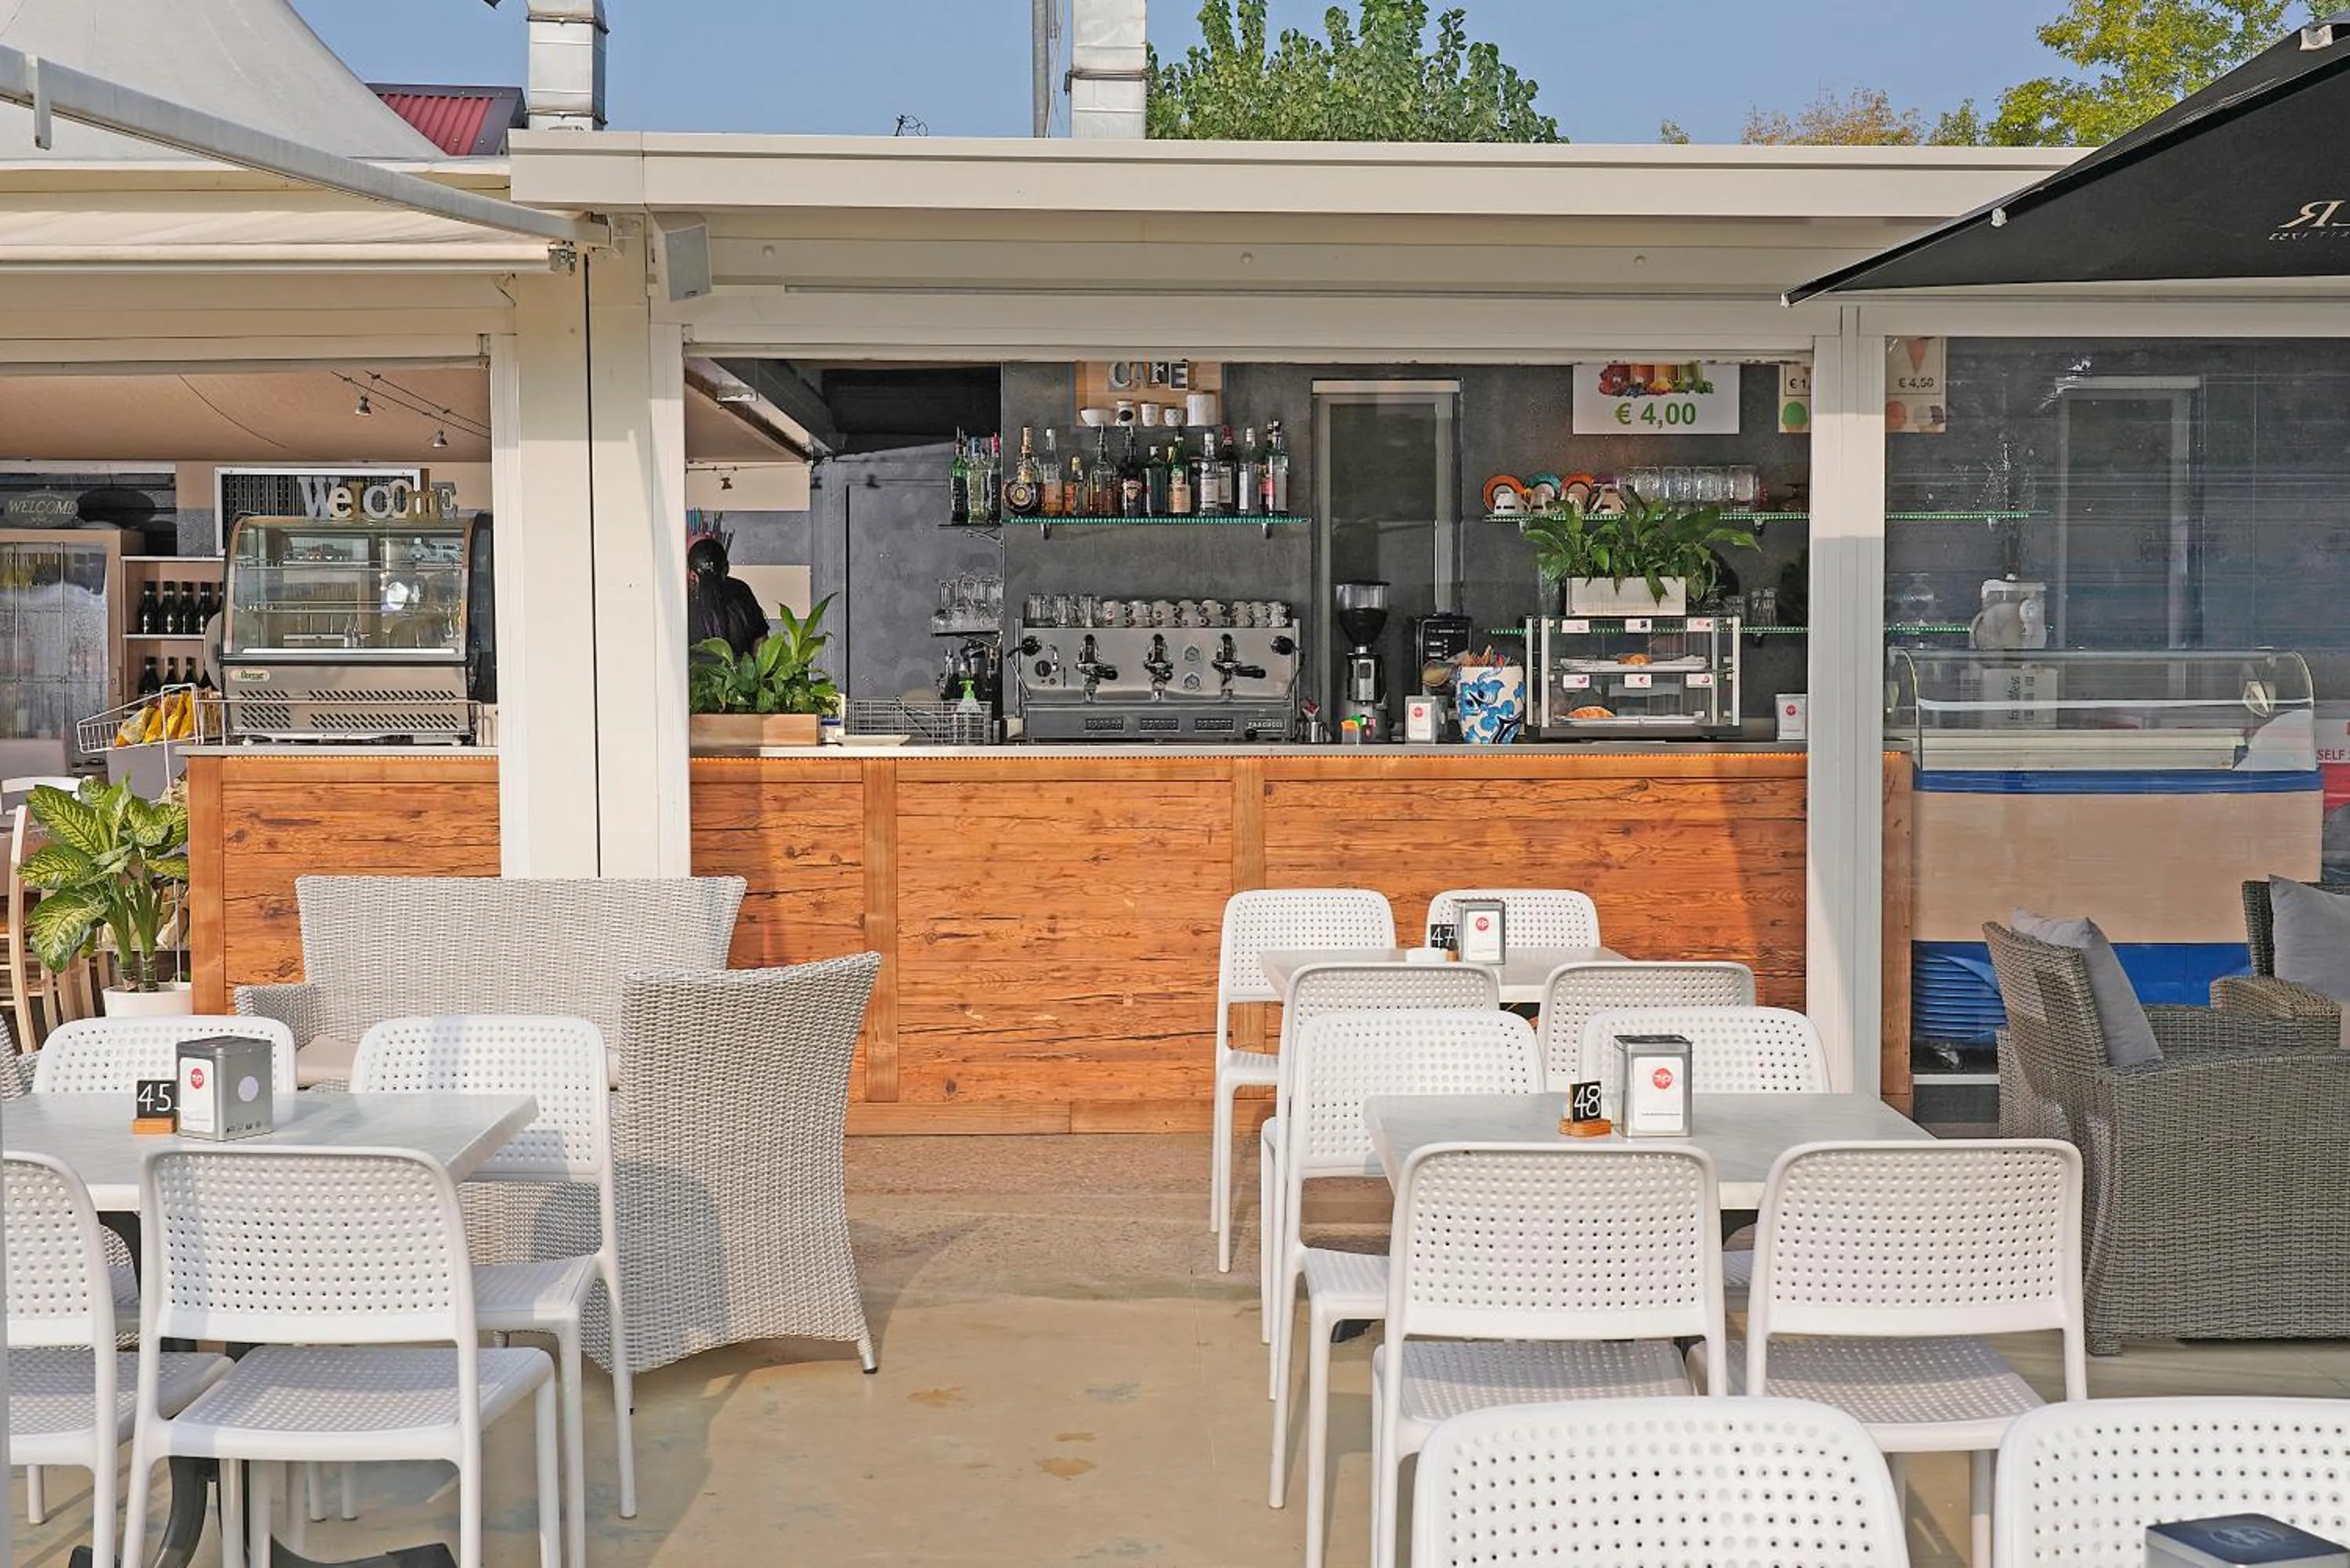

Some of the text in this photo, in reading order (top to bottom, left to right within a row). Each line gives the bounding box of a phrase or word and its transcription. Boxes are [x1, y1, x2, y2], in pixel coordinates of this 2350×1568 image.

[1614, 402, 1696, 428] € 4,00
[2317, 749, 2345, 761] SELF
[1431, 926, 1455, 947] 47
[136, 1083, 173, 1112] 45
[1574, 1085, 1600, 1118] 48
